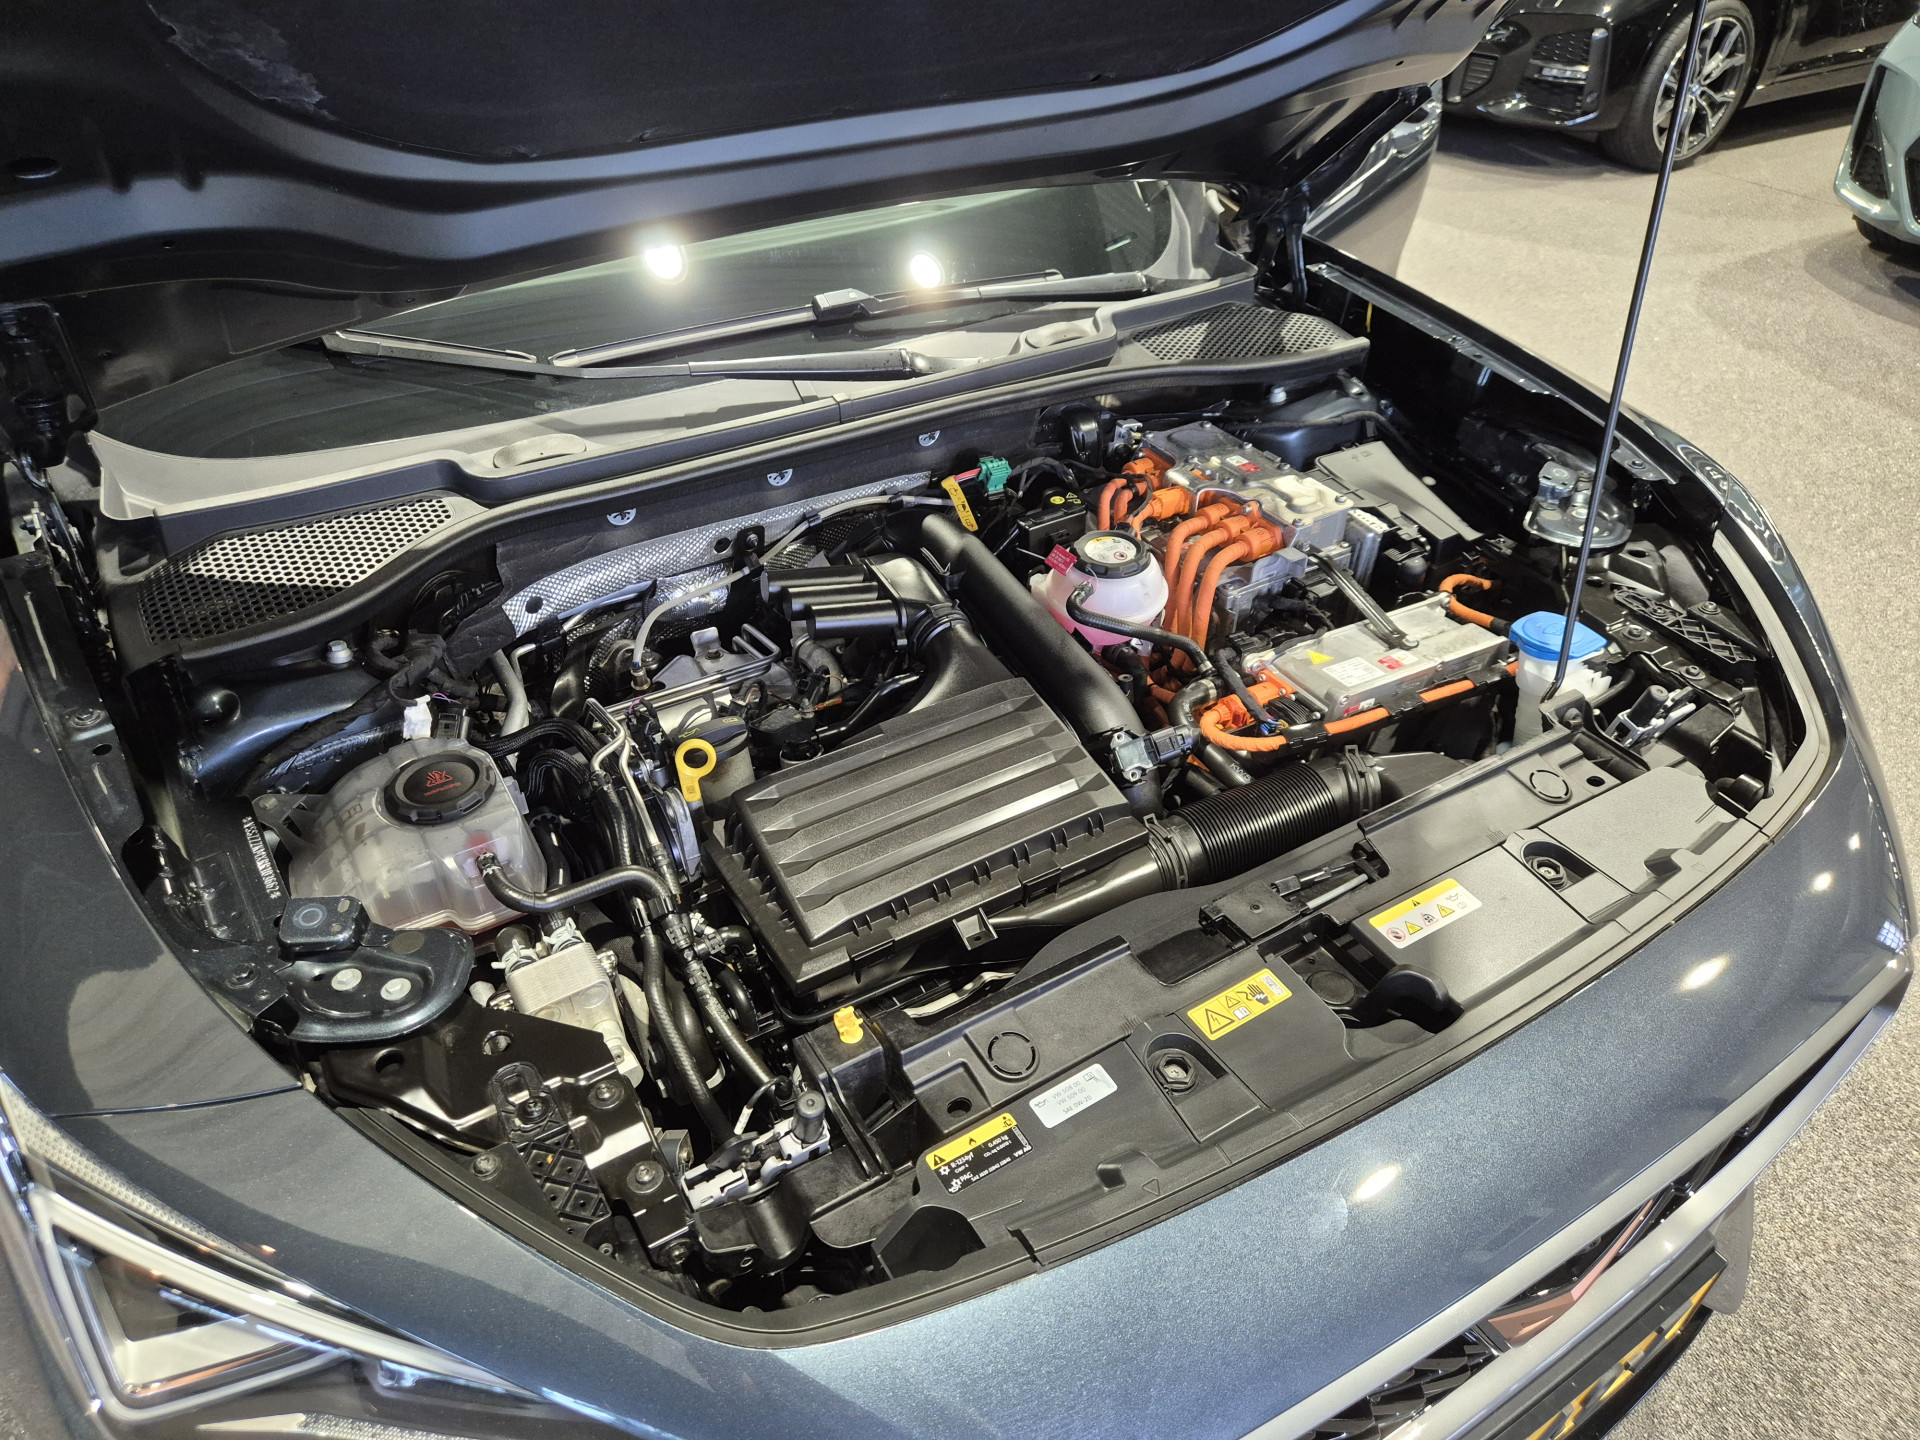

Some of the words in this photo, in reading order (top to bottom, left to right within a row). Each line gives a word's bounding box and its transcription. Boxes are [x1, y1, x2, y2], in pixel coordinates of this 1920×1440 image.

[1057, 1098, 1067, 1106] VW
[1062, 1105, 1074, 1114] SAE
[1013, 1148, 1024, 1158] VW
[960, 1171, 973, 1182] PAG
